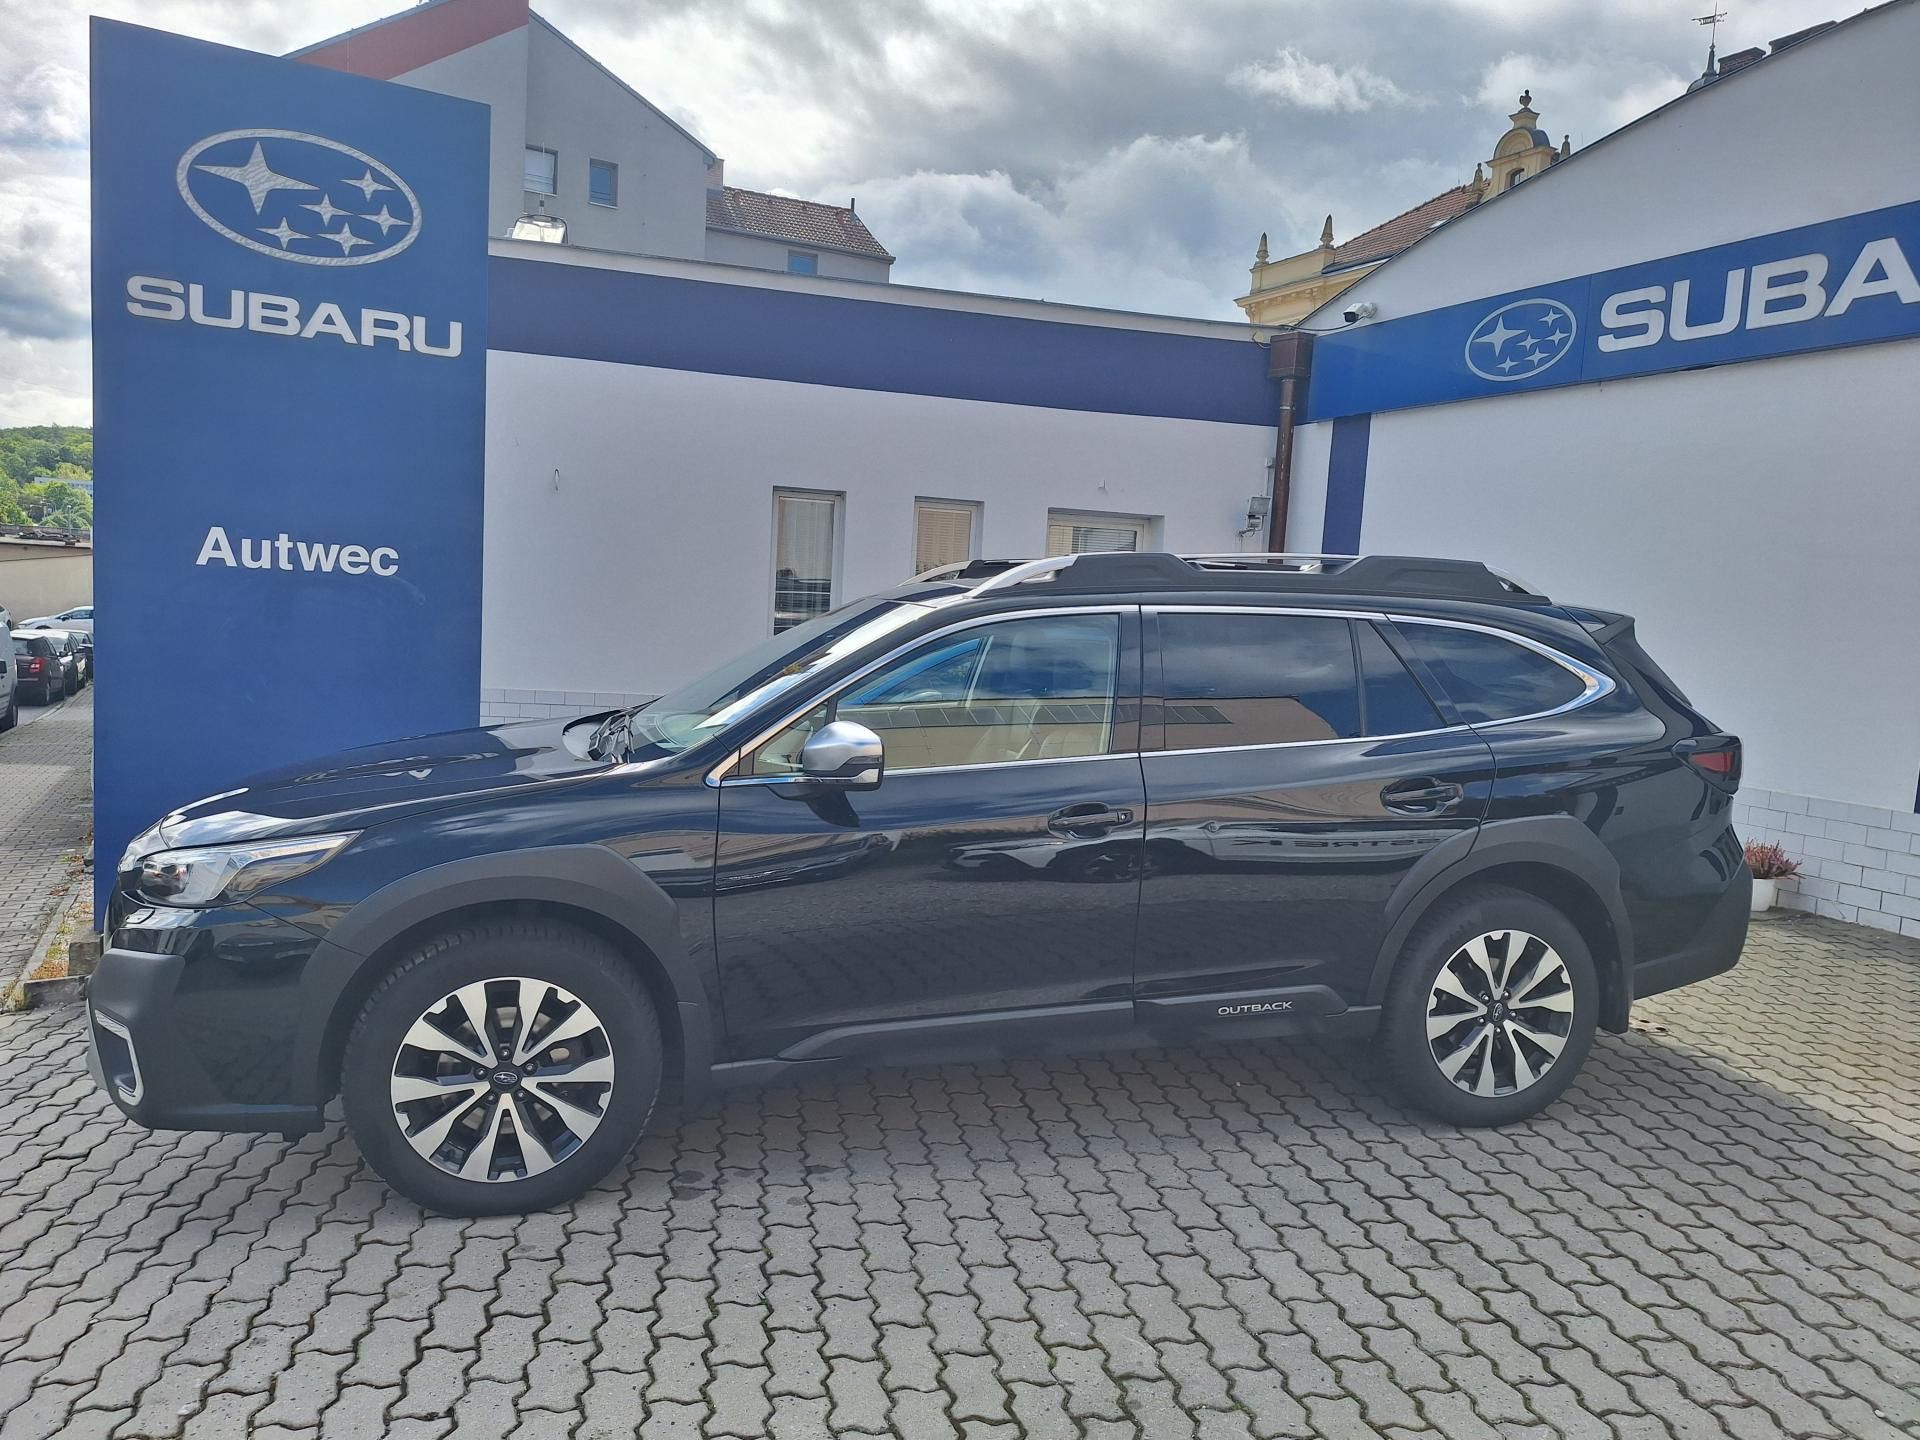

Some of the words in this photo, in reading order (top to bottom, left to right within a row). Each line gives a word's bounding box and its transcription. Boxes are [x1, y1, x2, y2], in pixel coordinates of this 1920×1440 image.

[126, 275, 463, 358] SUBARU
[1598, 237, 1920, 353] SUBA
[196, 526, 399, 577] Autwec
[1217, 1001, 1293, 1015] OUTBACK
